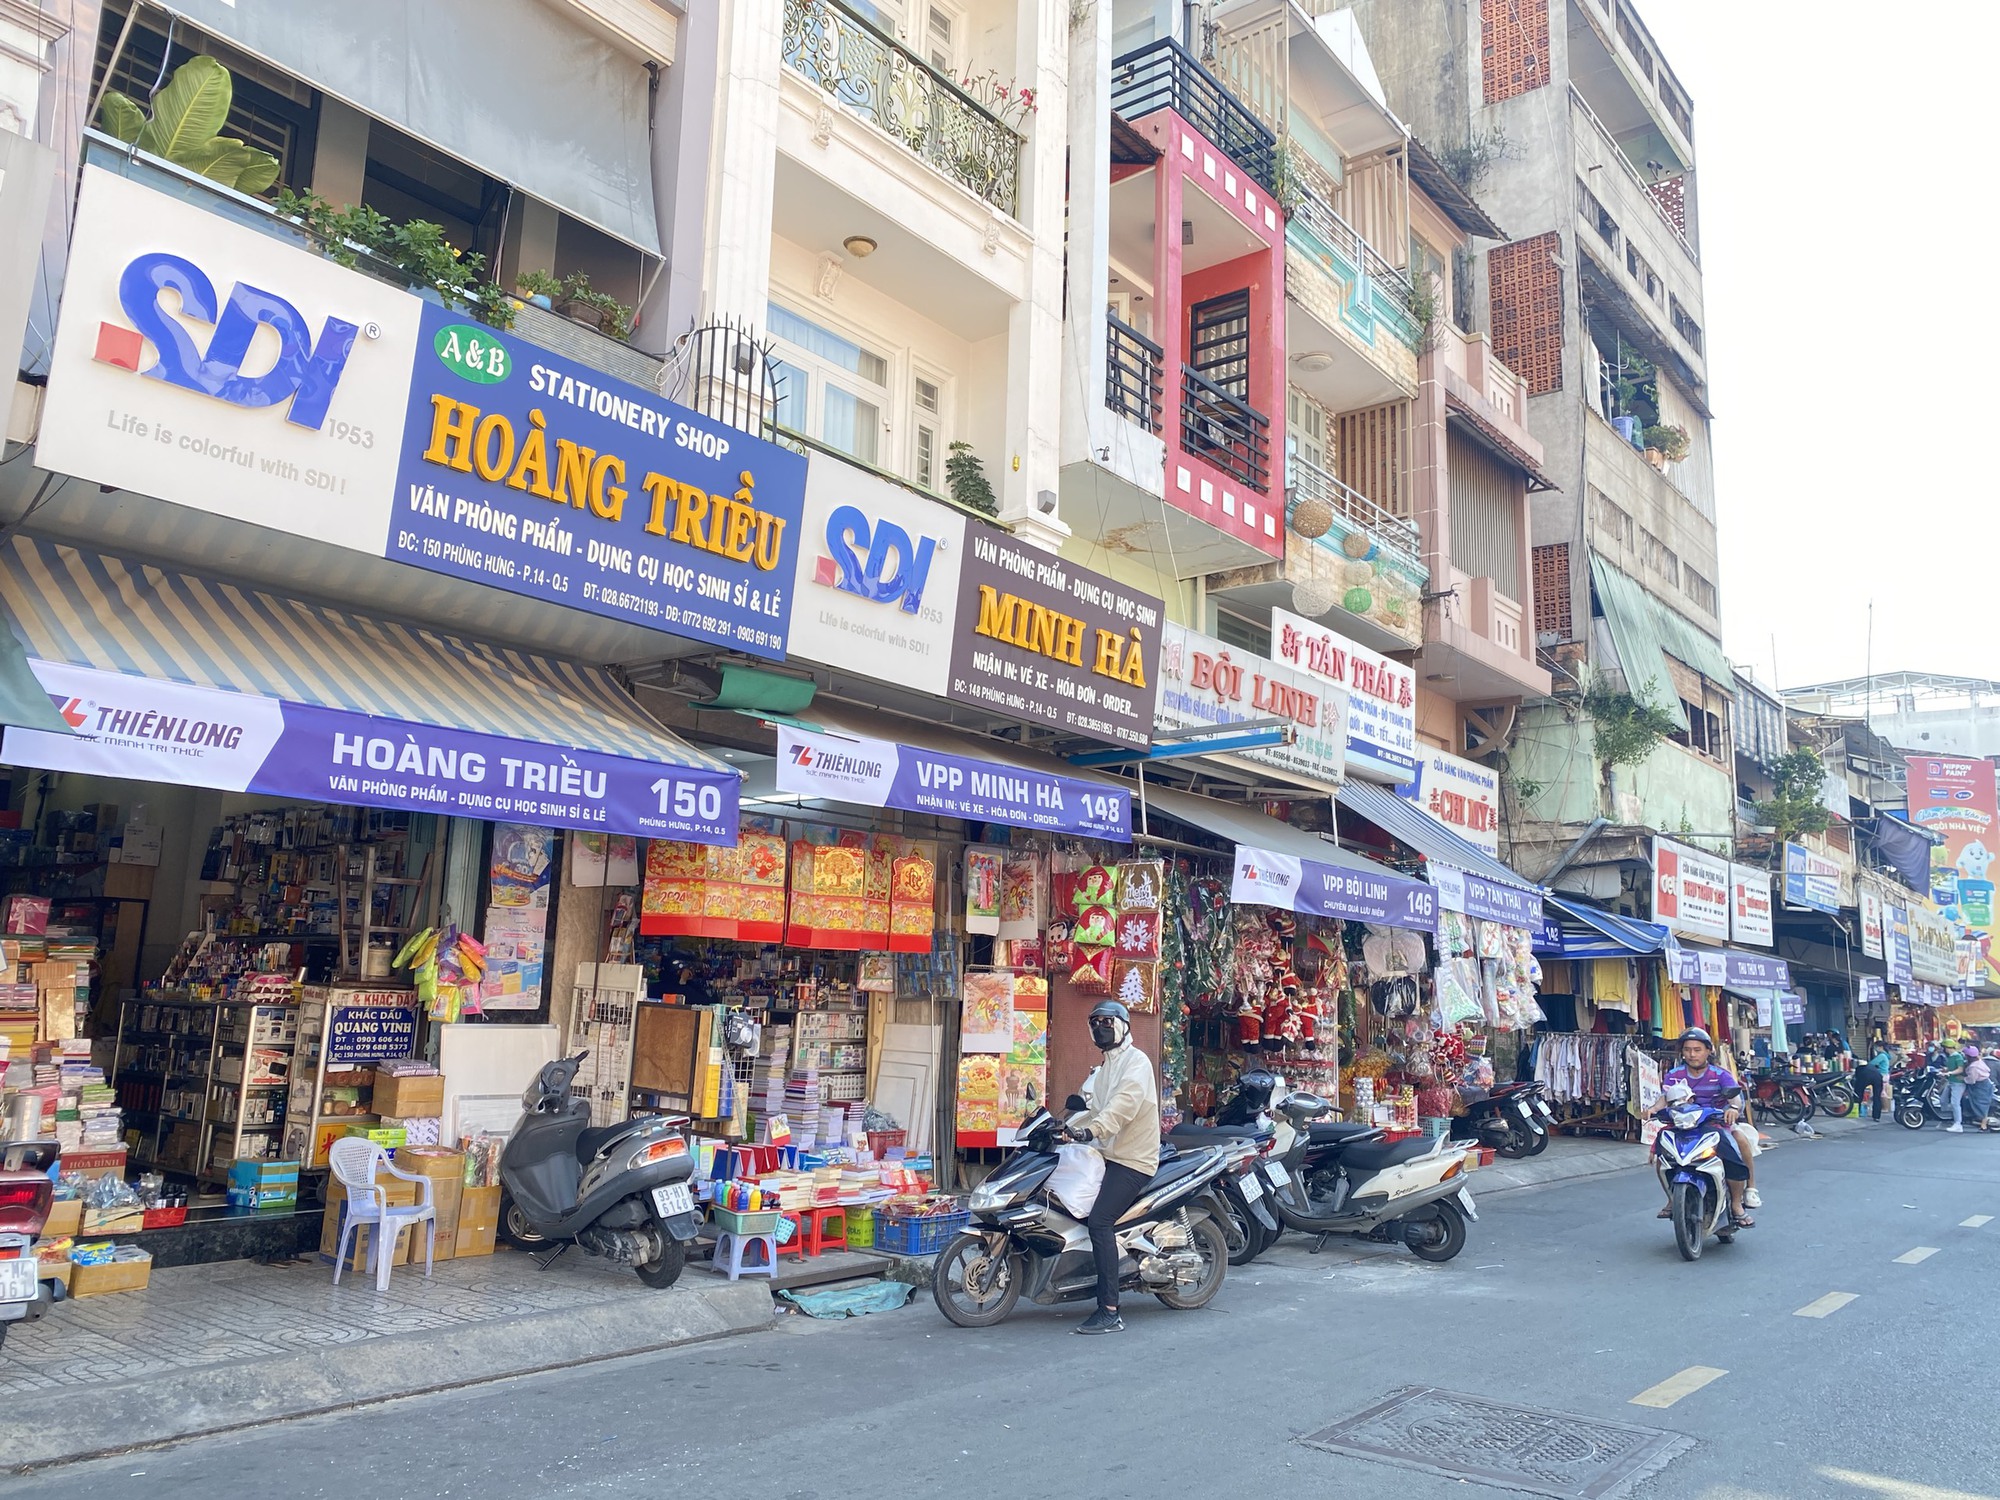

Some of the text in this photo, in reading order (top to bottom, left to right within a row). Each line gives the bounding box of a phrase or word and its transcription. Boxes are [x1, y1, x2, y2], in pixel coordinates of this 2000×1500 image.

[118, 252, 360, 431] SDI
[440, 330, 506, 379] A&B
[327, 417, 375, 450] 1953
[528, 363, 730, 462] STATIONERY SHOP
[107, 409, 335, 493] Life is colorful with SDI
[422, 393, 787, 571] HOÀNG TRIỀU
[410, 483, 782, 619] VĂN PHÒNG PHẨM DỤNG CỤ HỌC SINH SỈ & LẺ
[825, 504, 937, 616] SDI
[398, 530, 782, 651] ĐC: 150 PHÙNG HƯNG P.14 Q.5 ĐT: 028.66721193 DĐ: 0772 692 291 0903 691 190
[974, 536, 1158, 629] VĂN PHÒNG PHẨM DỤNG CỤ HỌC SINH
[818, 610, 908, 650] Life is colorful with
[920, 605, 944, 625] 1953
[974, 583, 1147, 689] MINH HÀ
[972, 650, 1139, 719] NHẬN IN: VÉ XE HÓA ĐƠN ORDER...
[1190, 651, 1320, 729] BỘI LINH
[1305, 634, 1397, 703] TÂN THÁI
[954, 678, 968, 694] ĐC:
[968, 682, 982, 699] 148
[981, 684, 1006, 707] PHÙNG
[1006, 692, 1025, 711] HƯNG
[1028, 699, 1043, 716] P.14
[1046, 704, 1058, 720] Q.5
[1066, 711, 1078, 726] ĐT:
[95, 706, 245, 751] THIÊNLONG
[331, 731, 722, 822] HOÀNG TRIỀU 150
[815, 751, 883, 779] THIÊNLONG
[1444, 761, 1458, 779] HÀNG
[1942, 763, 1972, 771] NIPPON
[1945, 769, 1968, 777] PAINT
[328, 772, 607, 823] VĂN PHÒNG PHẨM DỤNG CỤ HỌC SINH SỈ & LẺ
[915, 760, 1121, 823] VPP MINH HÀ 148
[915, 794, 944, 811] NHẬN
[943, 797, 958, 812] IN:
[959, 797, 972, 814] VÉ
[972, 802, 985, 815] XE
[990, 803, 1009, 819] HÓA
[1009, 807, 1028, 821] ĐƠN
[1440, 789, 1466, 827] CHI
[639, 815, 714, 836] PHÙNG HƯNG, P.14,
[1948, 821, 1987, 835] NHÀ VIỆT
[1322, 873, 1433, 917] VPP BỘI LINH 146
[1323, 899, 1347, 912] CHUYÊN
[1468, 881, 1486, 901] VPP
[1486, 884, 1504, 906] TÂN
[1503, 890, 1522, 911] THÁI
[334, 1021, 412, 1035] QUANG VINH
[347, 1007, 403, 1020] KHẮC DẤU
[355, 1043, 408, 1051] 079 688 5373
[93, 1157, 120, 1168] BÌNH
[1013, 1220, 1036, 1230] HONDA
